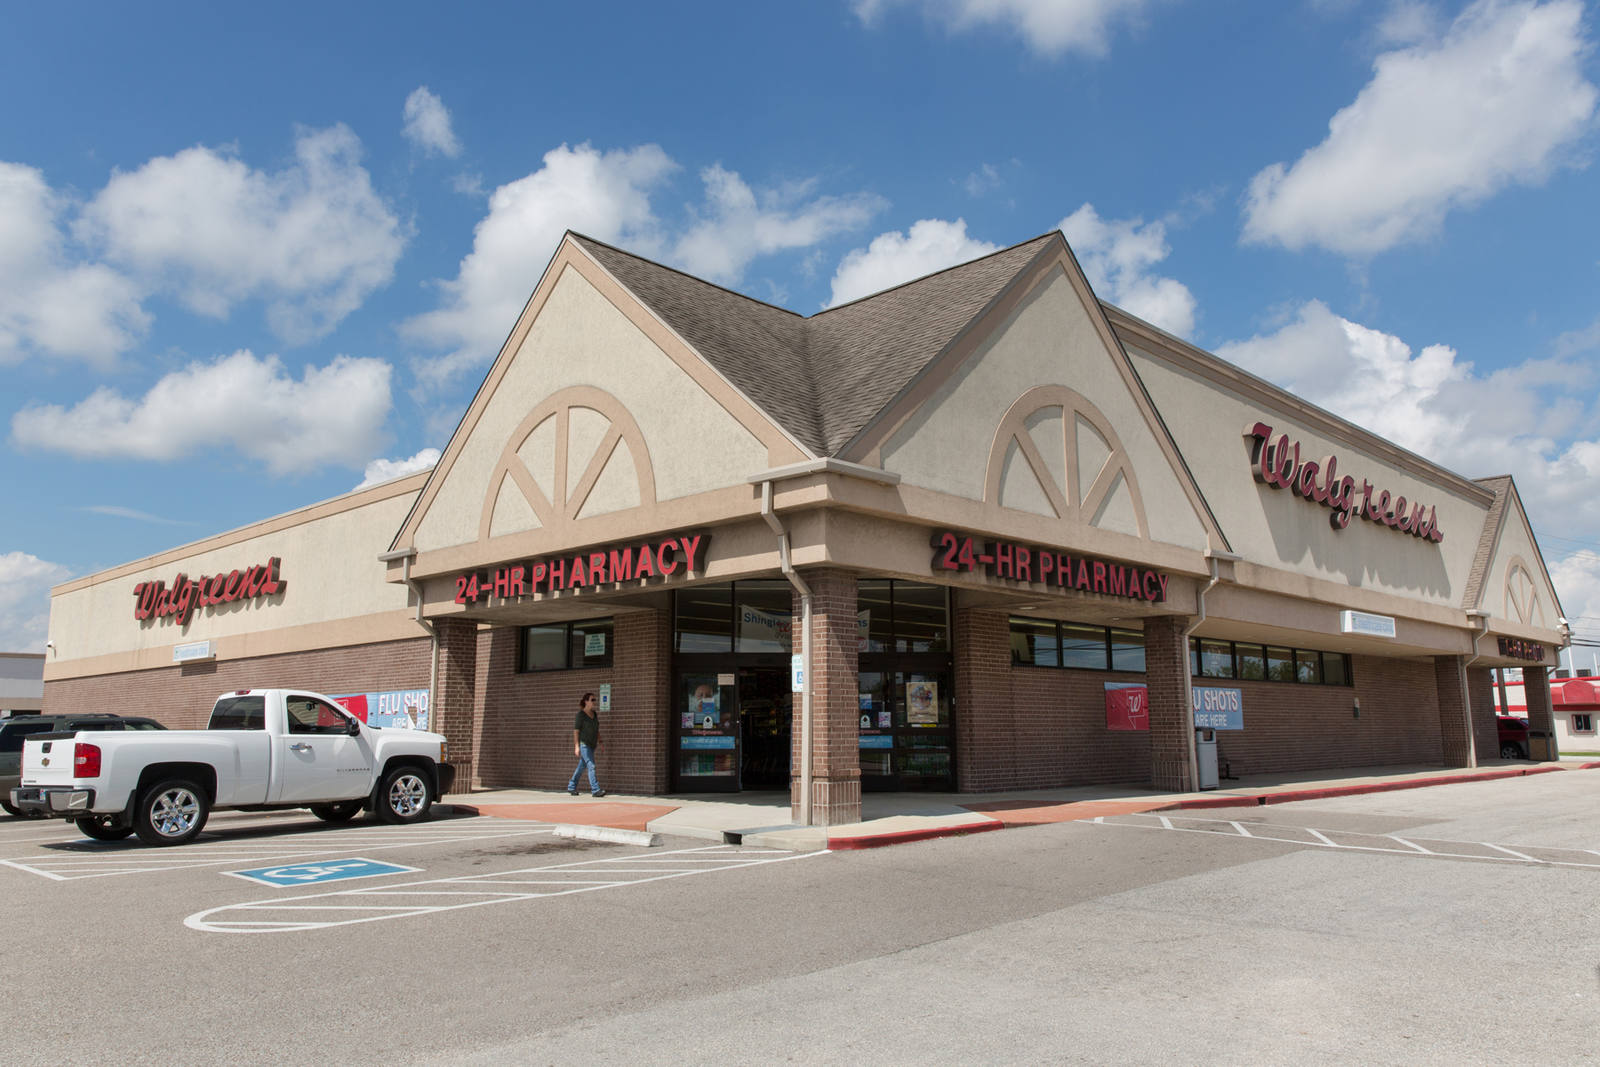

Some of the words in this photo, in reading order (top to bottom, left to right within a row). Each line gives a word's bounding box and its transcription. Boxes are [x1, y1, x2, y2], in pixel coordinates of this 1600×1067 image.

[1250, 422, 1444, 543] Walgreens
[455, 565, 525, 604] 24-HR
[532, 535, 700, 595] PHARMACY
[942, 533, 1032, 582] 24-HR
[1039, 551, 1169, 602] PHARMACY
[134, 557, 281, 626] Walgreens
[744, 612, 777, 628] Shingl
[378, 693, 401, 716] FLU
[403, 692, 429, 715] SHO
[1195, 713, 1209, 727] ARE
[1209, 713, 1228, 727] HERE
[1204, 690, 1238, 712] SHOTS
